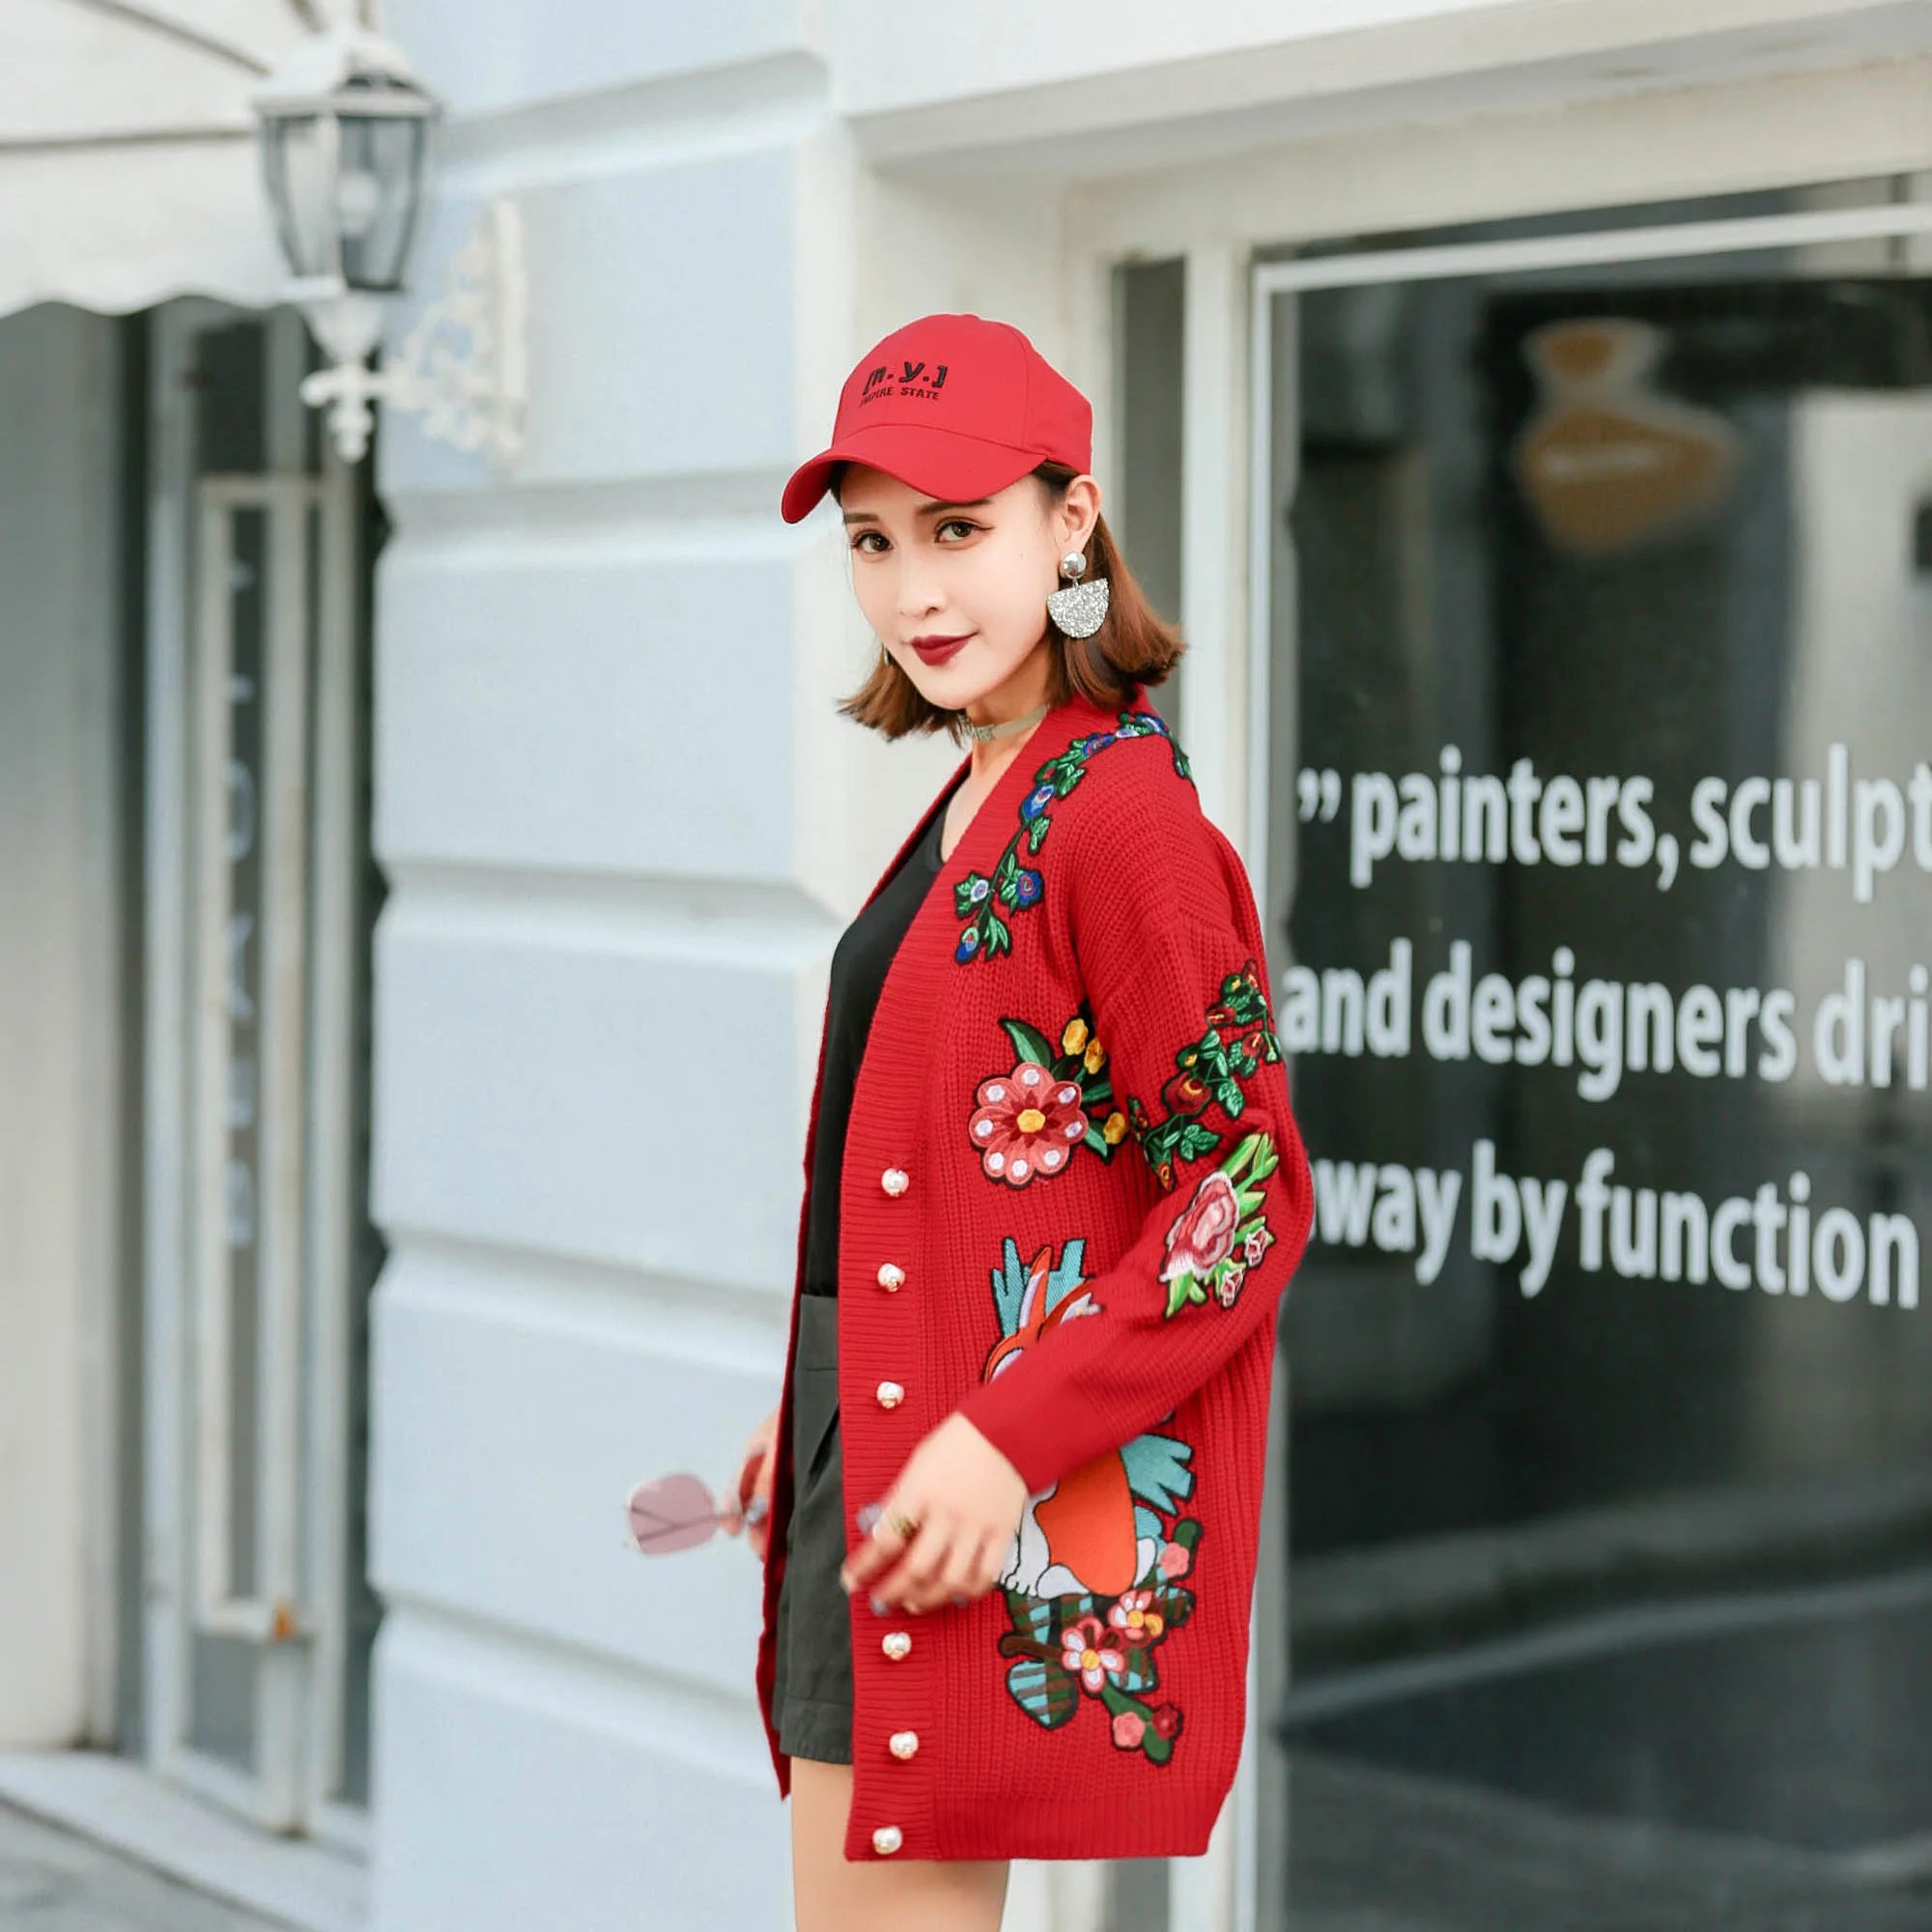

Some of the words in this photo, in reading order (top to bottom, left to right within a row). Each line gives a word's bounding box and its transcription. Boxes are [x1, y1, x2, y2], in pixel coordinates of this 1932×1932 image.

[900, 386, 939, 401] STATE
[1690, 743, 1932, 903] sculpt
[1279, 936, 1411, 1058] and
[1423, 939, 1797, 1102] designers
[1813, 957, 1929, 1091] dri
[1309, 1157, 1462, 1286] way
[1471, 1139, 1567, 1298] by
[1576, 1148, 1919, 1309] function
